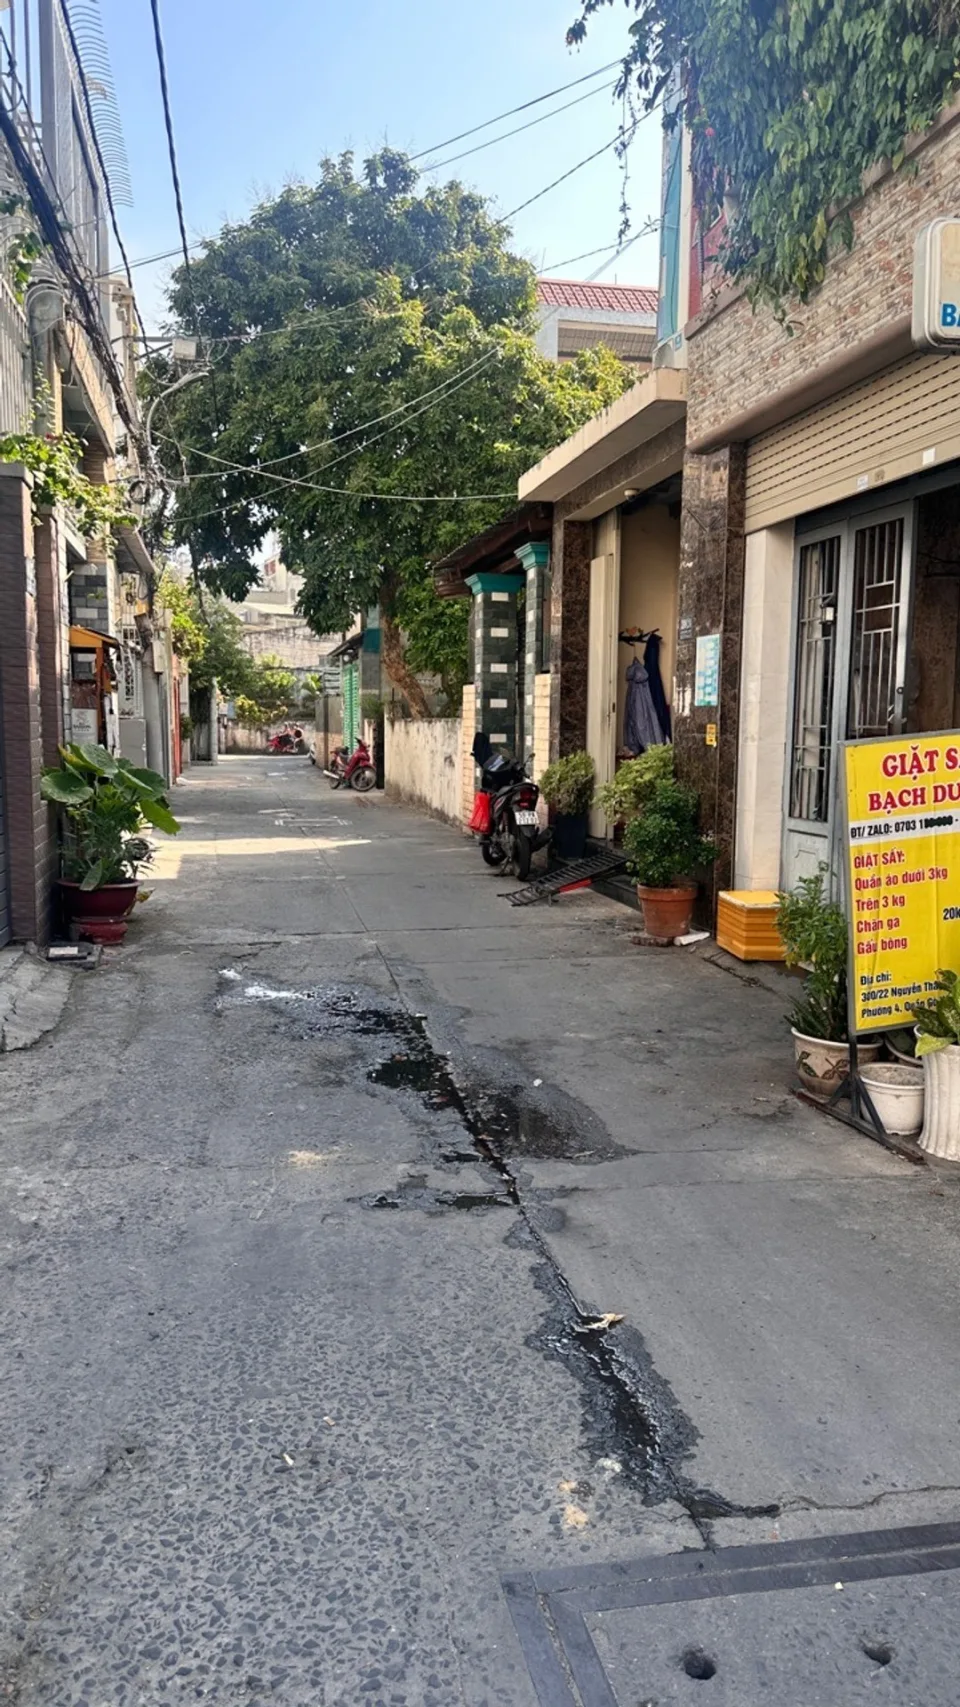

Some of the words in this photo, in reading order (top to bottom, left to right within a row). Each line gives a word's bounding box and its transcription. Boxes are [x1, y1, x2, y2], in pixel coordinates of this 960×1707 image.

[941, 303, 960, 327] B
[882, 745, 939, 781] GIẶT
[945, 747, 960, 770] S
[868, 786, 926, 814] BẠCH
[850, 825, 866, 839] ĐT/
[868, 822, 893, 836] ZALO:
[894, 820, 916, 833] 0703
[854, 852, 879, 870] GIẶT
[882, 847, 905, 865] SẤY:
[885, 873, 899, 887] áo
[928, 867, 948, 880] 3kg
[855, 898, 880, 912] Trên
[882, 895, 889, 908] 3
[892, 894, 905, 907] kg
[856, 918, 884, 933] Chăn
[887, 917, 900, 930] ga
[857, 938, 878, 955] Gấu
[860, 974, 874, 987] Địa
[861, 988, 889, 1003] 300/22
[891, 982, 922, 997] Nguyễn
[861, 1005, 892, 1019] Phường
